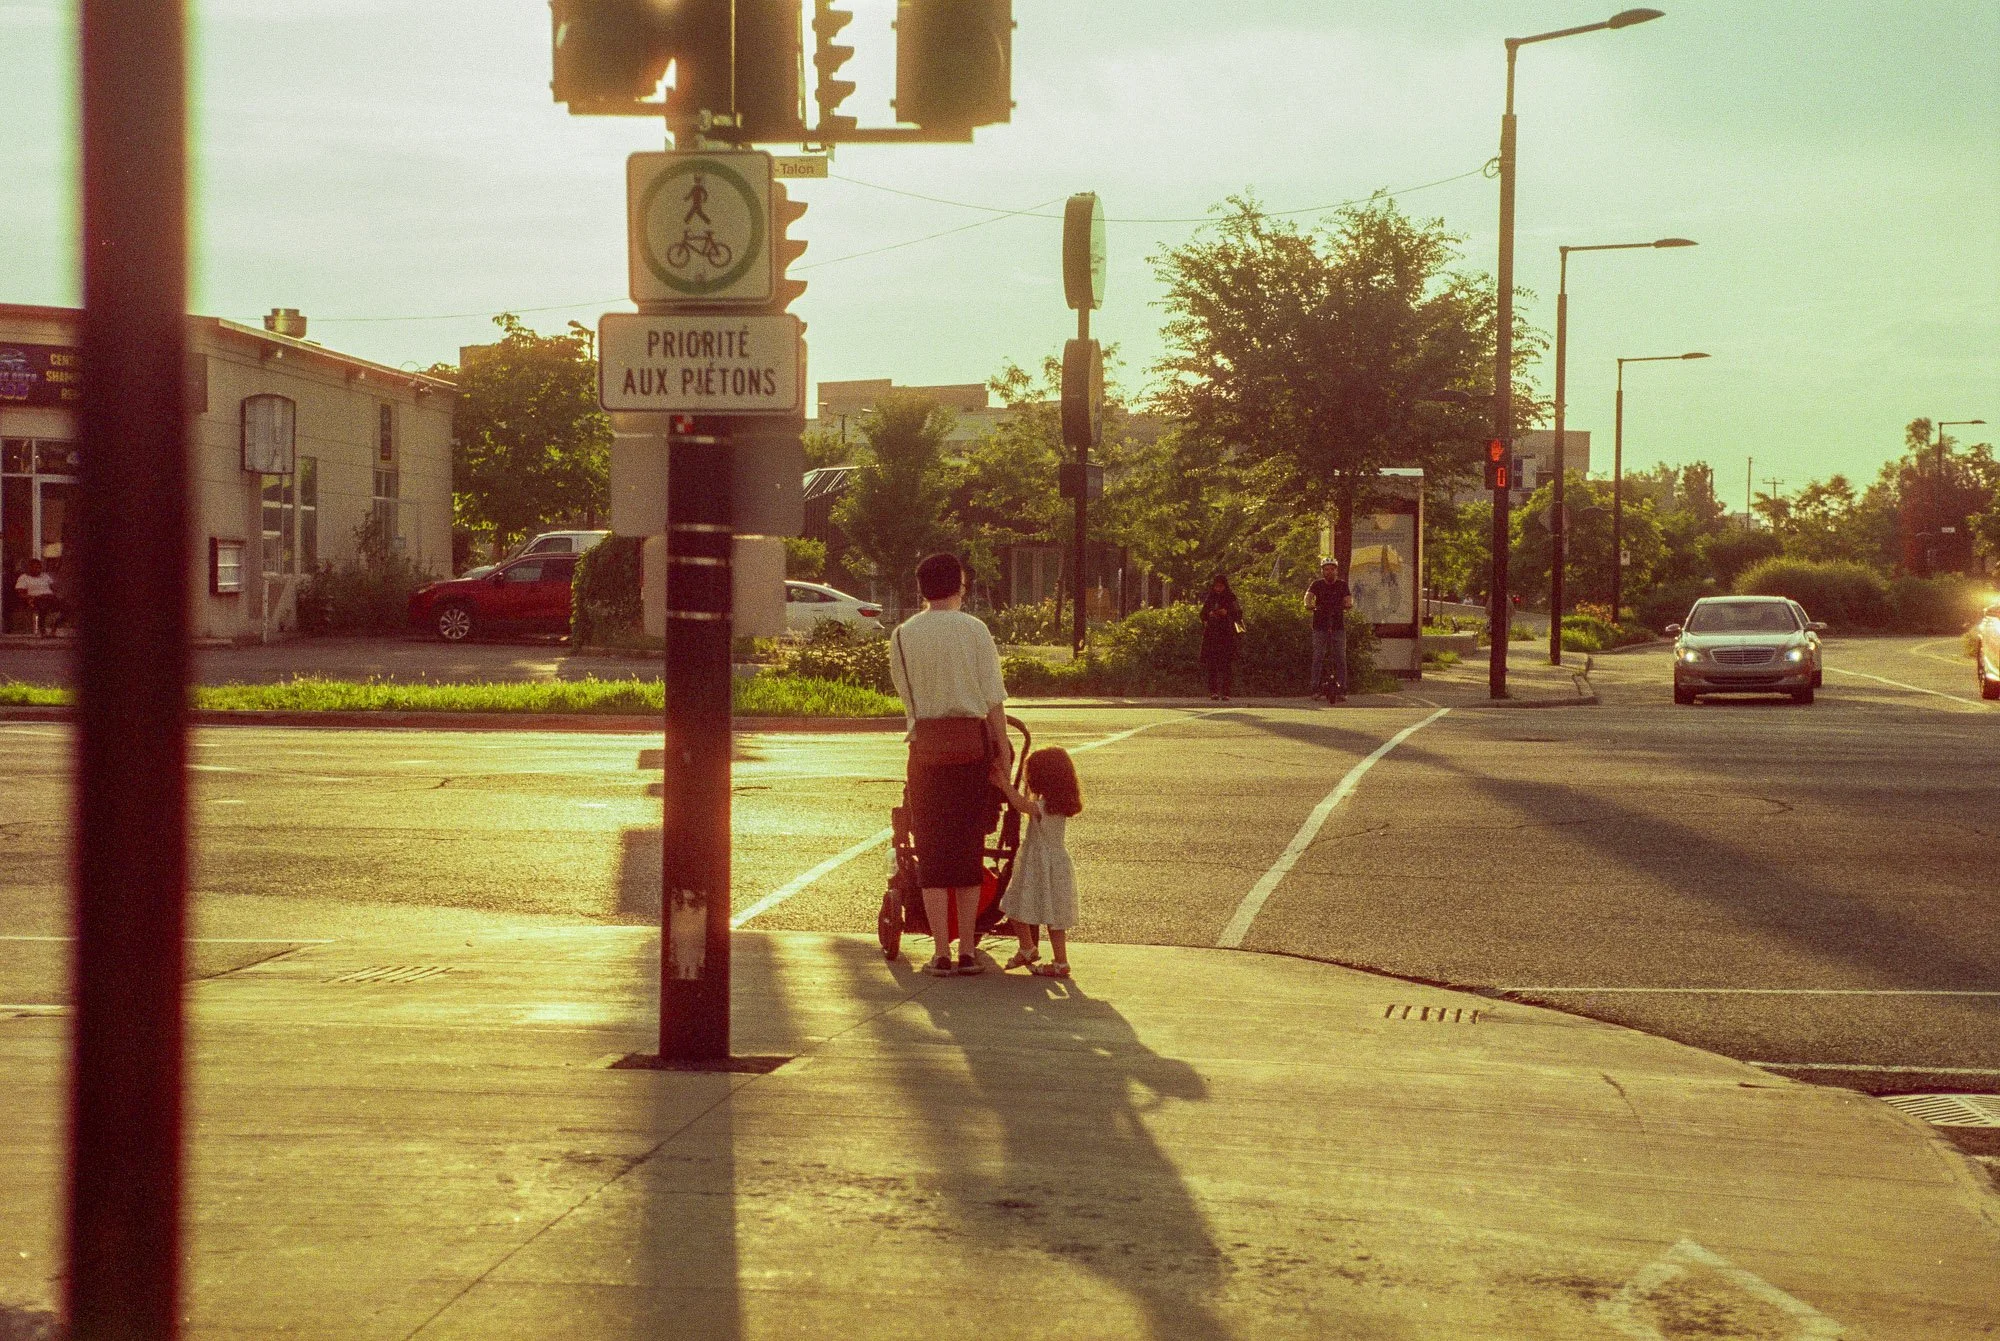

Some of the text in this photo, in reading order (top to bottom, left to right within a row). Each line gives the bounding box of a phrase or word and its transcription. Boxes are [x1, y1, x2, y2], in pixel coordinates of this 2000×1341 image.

[647, 325, 749, 358] PRIORITÉ
[623, 362, 776, 396] AUX PIÉTONS
